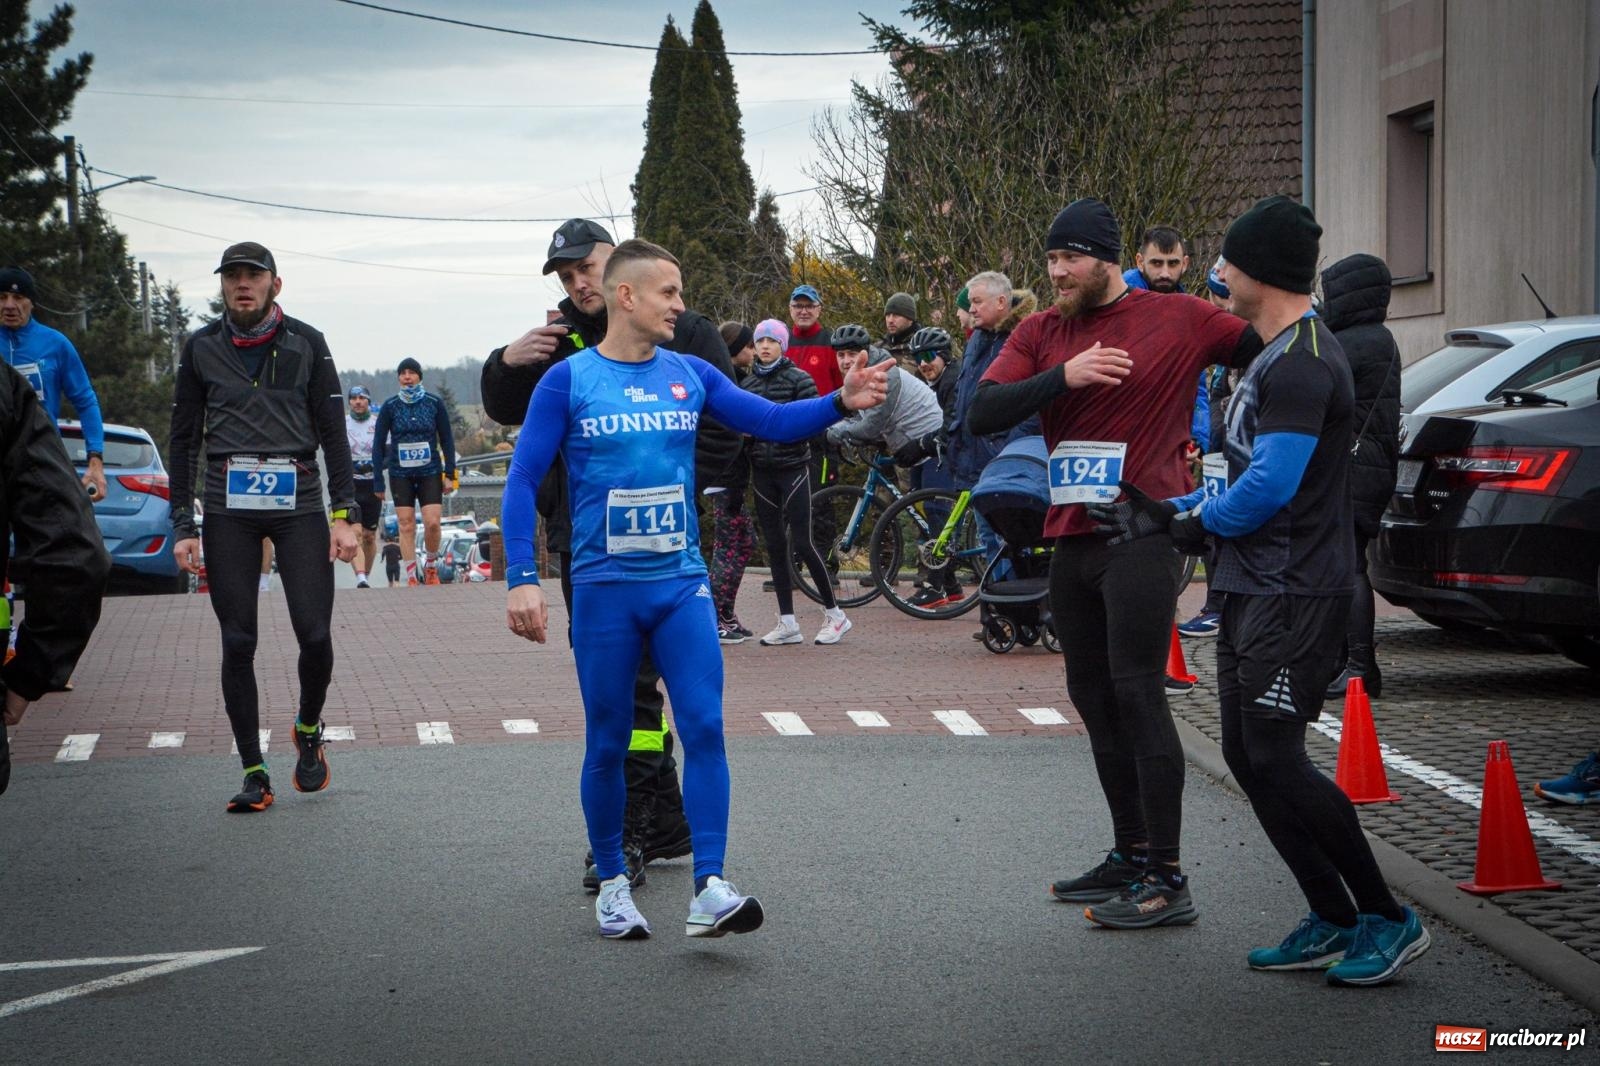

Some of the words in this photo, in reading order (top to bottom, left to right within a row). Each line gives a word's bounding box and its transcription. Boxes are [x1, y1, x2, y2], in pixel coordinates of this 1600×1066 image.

[580, 411, 698, 437] RUNNERS
[404, 450, 425, 460] 199
[246, 472, 278, 494] 29
[1059, 458, 1107, 484] 194
[624, 504, 676, 533] 114
